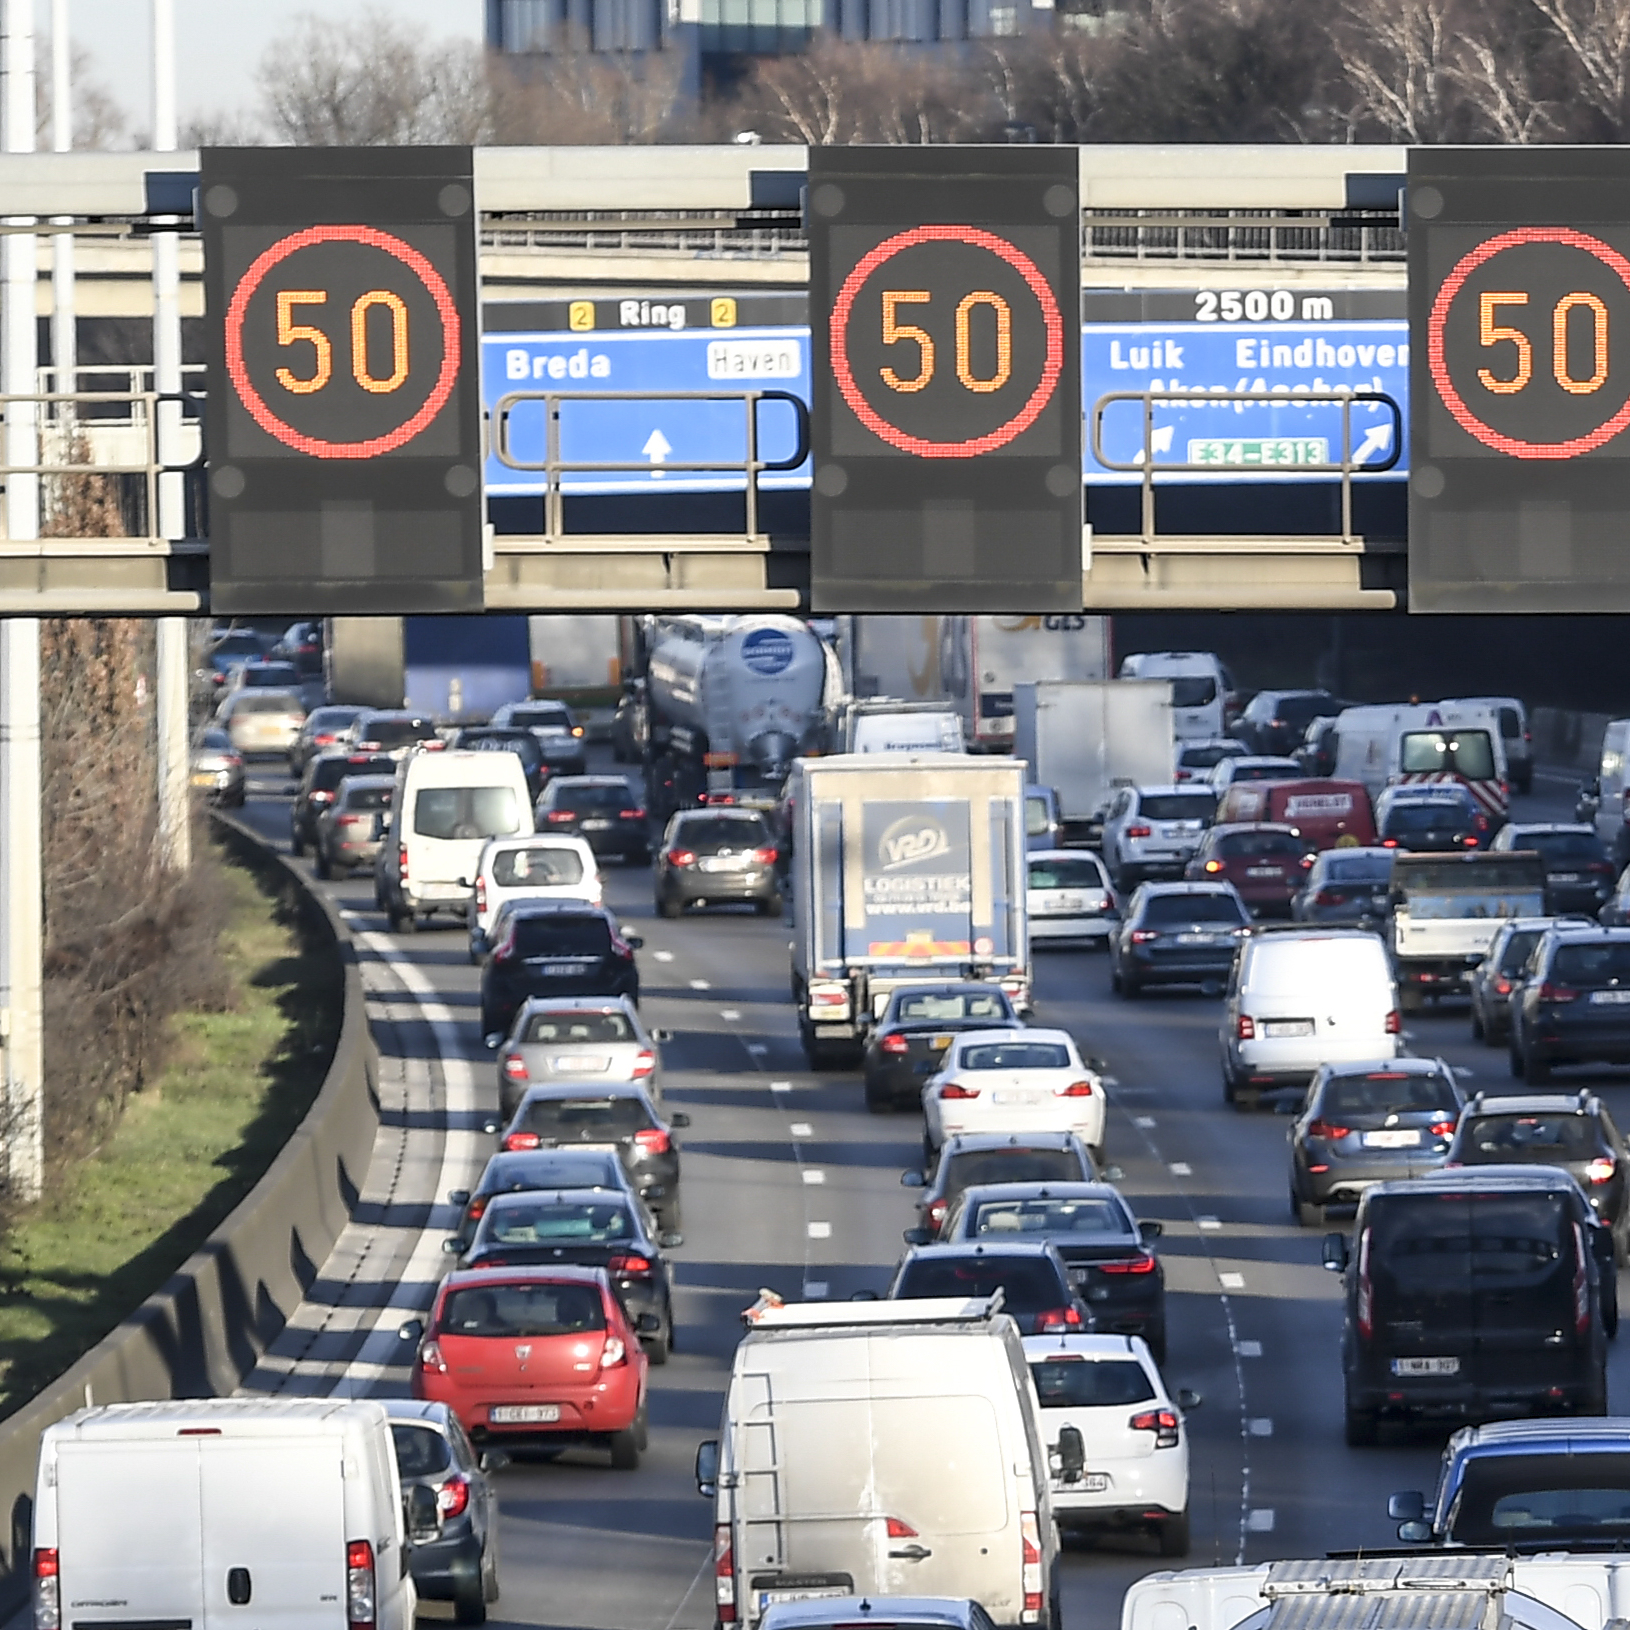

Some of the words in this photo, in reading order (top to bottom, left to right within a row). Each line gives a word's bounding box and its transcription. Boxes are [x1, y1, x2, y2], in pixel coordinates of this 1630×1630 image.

[619, 300, 686, 330] Ring
[1195, 290, 1295, 321] 2500
[1301, 296, 1334, 320] m
[275, 290, 409, 394] 50
[880, 290, 1012, 394] 50
[1110, 340, 1184, 369] Luik
[1476, 291, 1609, 394] 50
[506, 348, 611, 380] Breda
[713, 348, 791, 373] Haven
